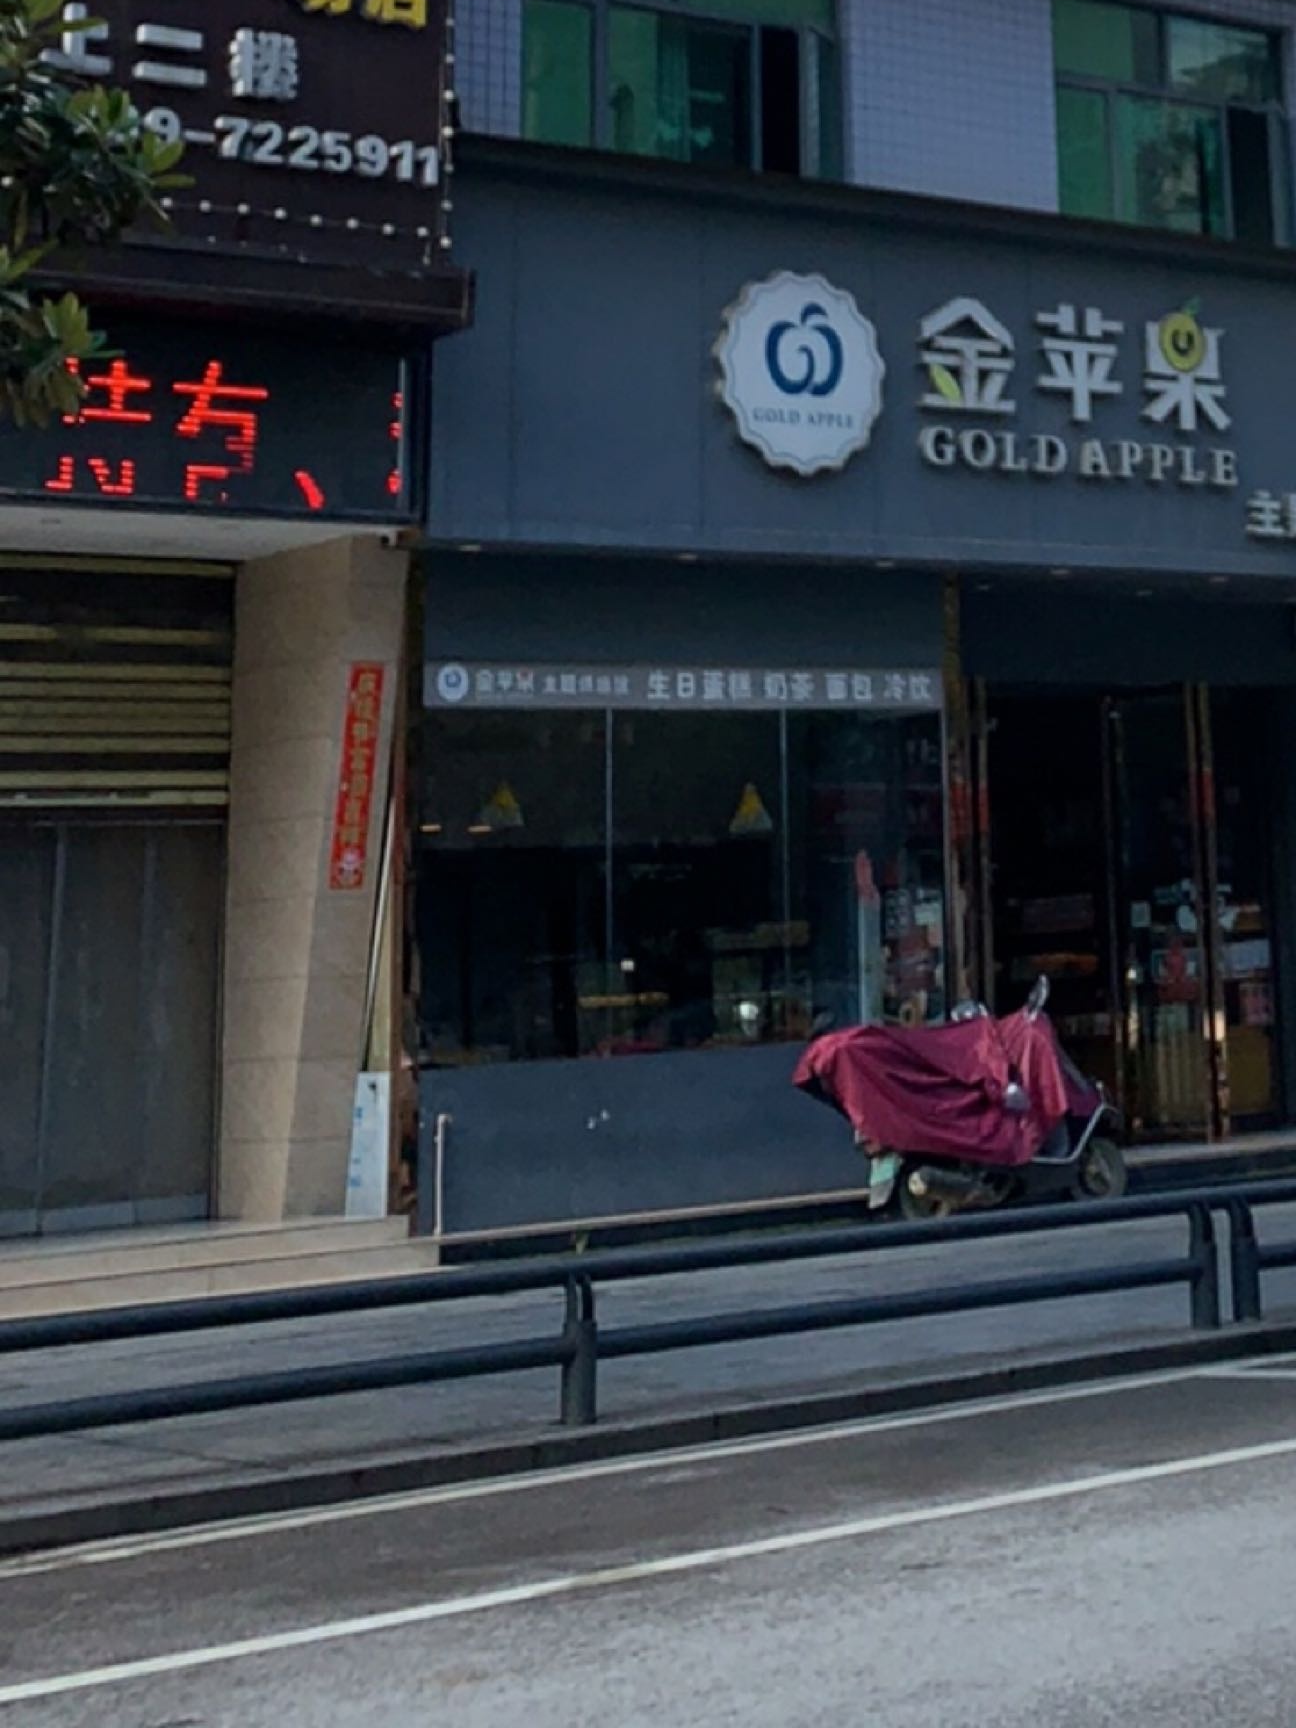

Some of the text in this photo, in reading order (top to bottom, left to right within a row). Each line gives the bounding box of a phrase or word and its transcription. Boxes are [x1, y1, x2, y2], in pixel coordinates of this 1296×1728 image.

[918, 295, 1233, 432] 金苹果
[921, 426, 1238, 487] GOLD APPLE
